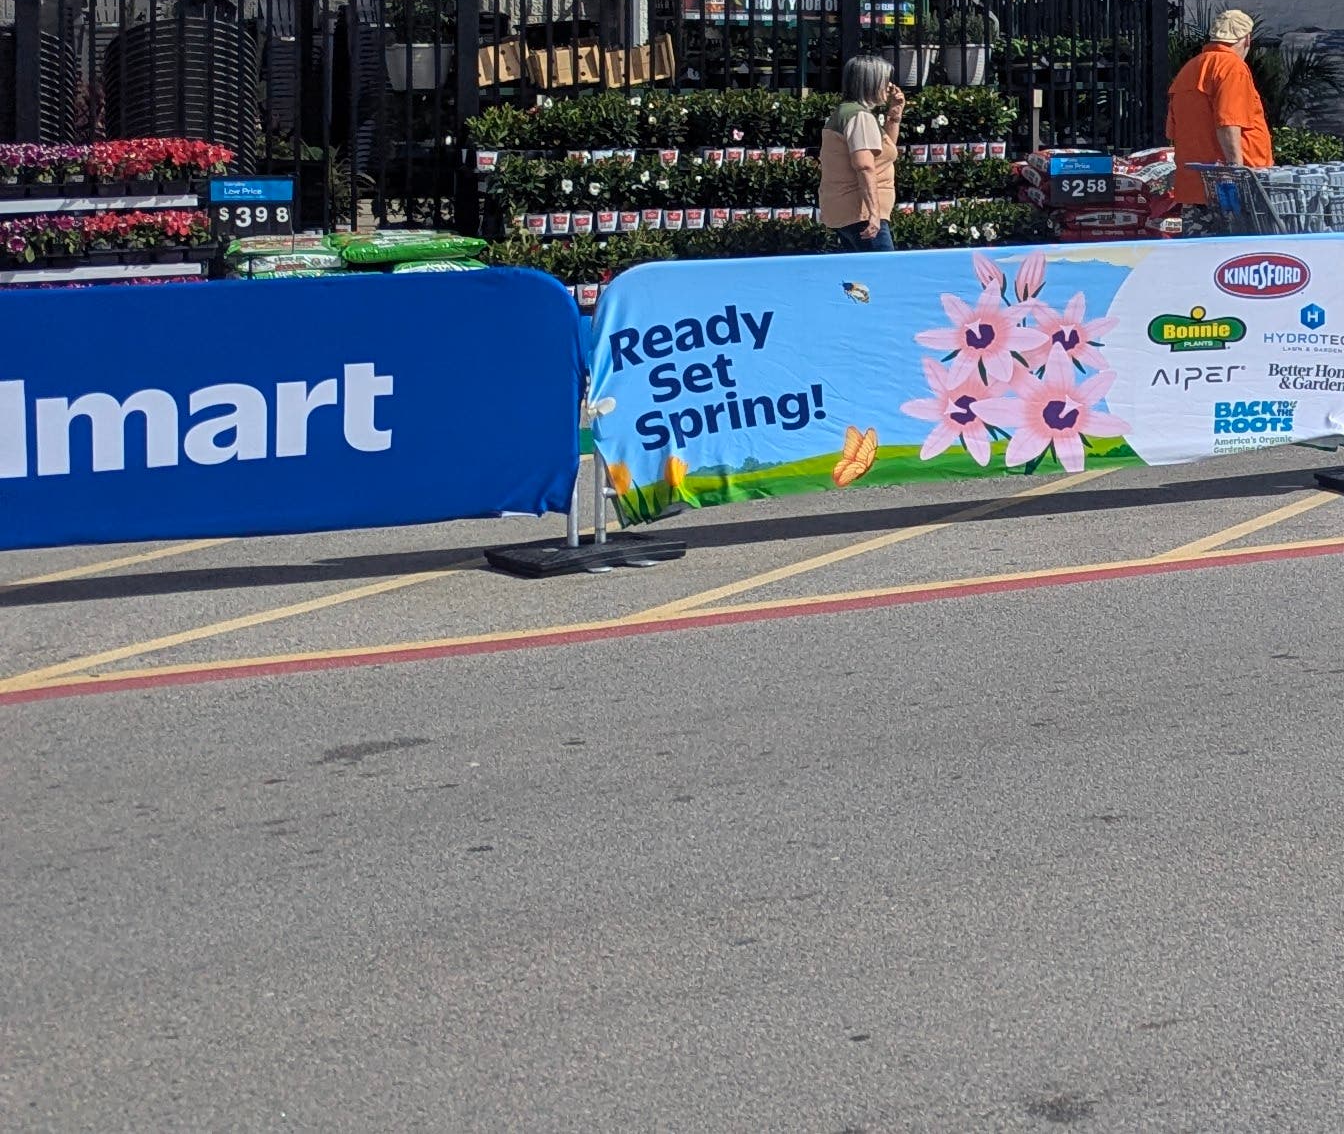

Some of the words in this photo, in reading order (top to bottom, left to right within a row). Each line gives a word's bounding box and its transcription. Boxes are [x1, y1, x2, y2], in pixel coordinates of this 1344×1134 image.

[1223, 260, 1302, 290] KINGSFORD
[608, 304, 775, 373] Ready
[1163, 323, 1231, 339] Bonnie
[1183, 340, 1214, 348] PLANTS
[648, 353, 737, 403] Set
[1268, 363, 1314, 378] Better
[1214, 401, 1277, 419] BACK
[1276, 409, 1294, 417] THE
[1277, 400, 1290, 409] TO
[0, 362, 394, 479] lmart
[635, 383, 828, 452] Spring!
[1213, 417, 1294, 434] ROOTS
[1214, 436, 1257, 446] America's
[1259, 435, 1293, 445] Organic
